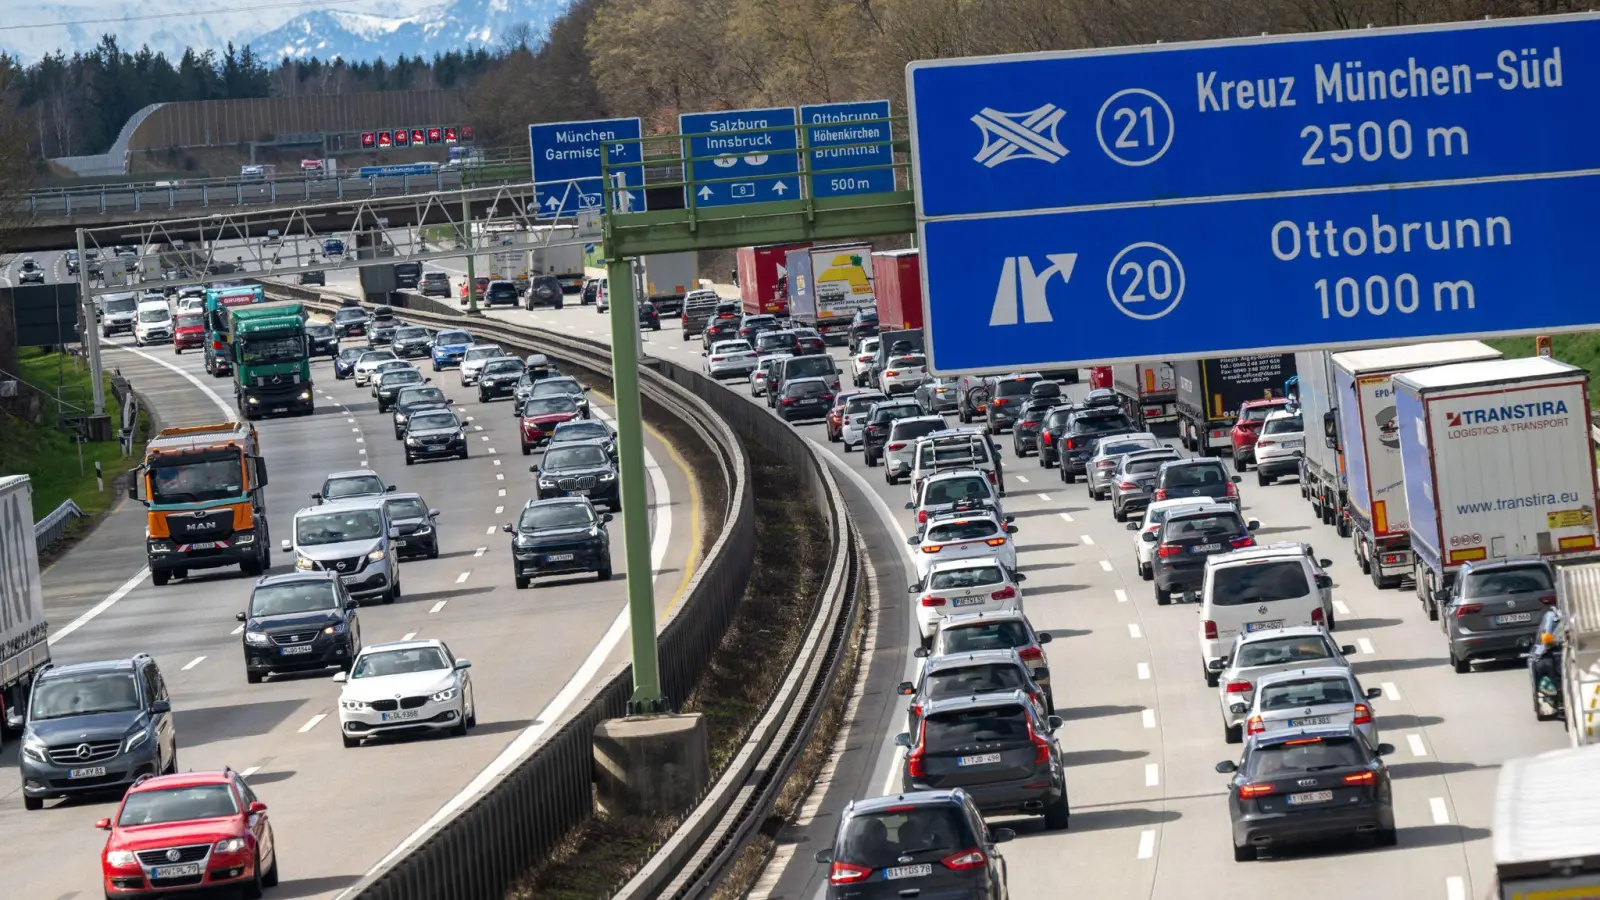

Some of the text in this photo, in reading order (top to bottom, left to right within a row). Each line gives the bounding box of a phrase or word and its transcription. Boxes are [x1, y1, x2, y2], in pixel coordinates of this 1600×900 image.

[1197, 47, 1562, 112] Kreuz München-Süd
[556, 129, 615, 143] München
[814, 127, 880, 142] Höhenkirchen
[1112, 104, 1156, 150] 21
[545, 144, 627, 160] Garmisc-P.
[706, 133, 772, 149] Innsbruck
[1300, 119, 1469, 165] 2500 m
[740, 185, 746, 195] 8
[831, 178, 870, 191] 500 m
[1271, 214, 1511, 261] Ottobrunn
[1119, 260, 1172, 303] 20
[1315, 273, 1475, 319] 1000 m
[1463, 400, 1569, 425] TRANSTIRA
[1448, 417, 1569, 439] LOGISTICS & TRANSPORT
[1457, 491, 1579, 515] www.transtira.eu
[186, 521, 216, 531] MAN
[920, 864, 931, 874] 78
